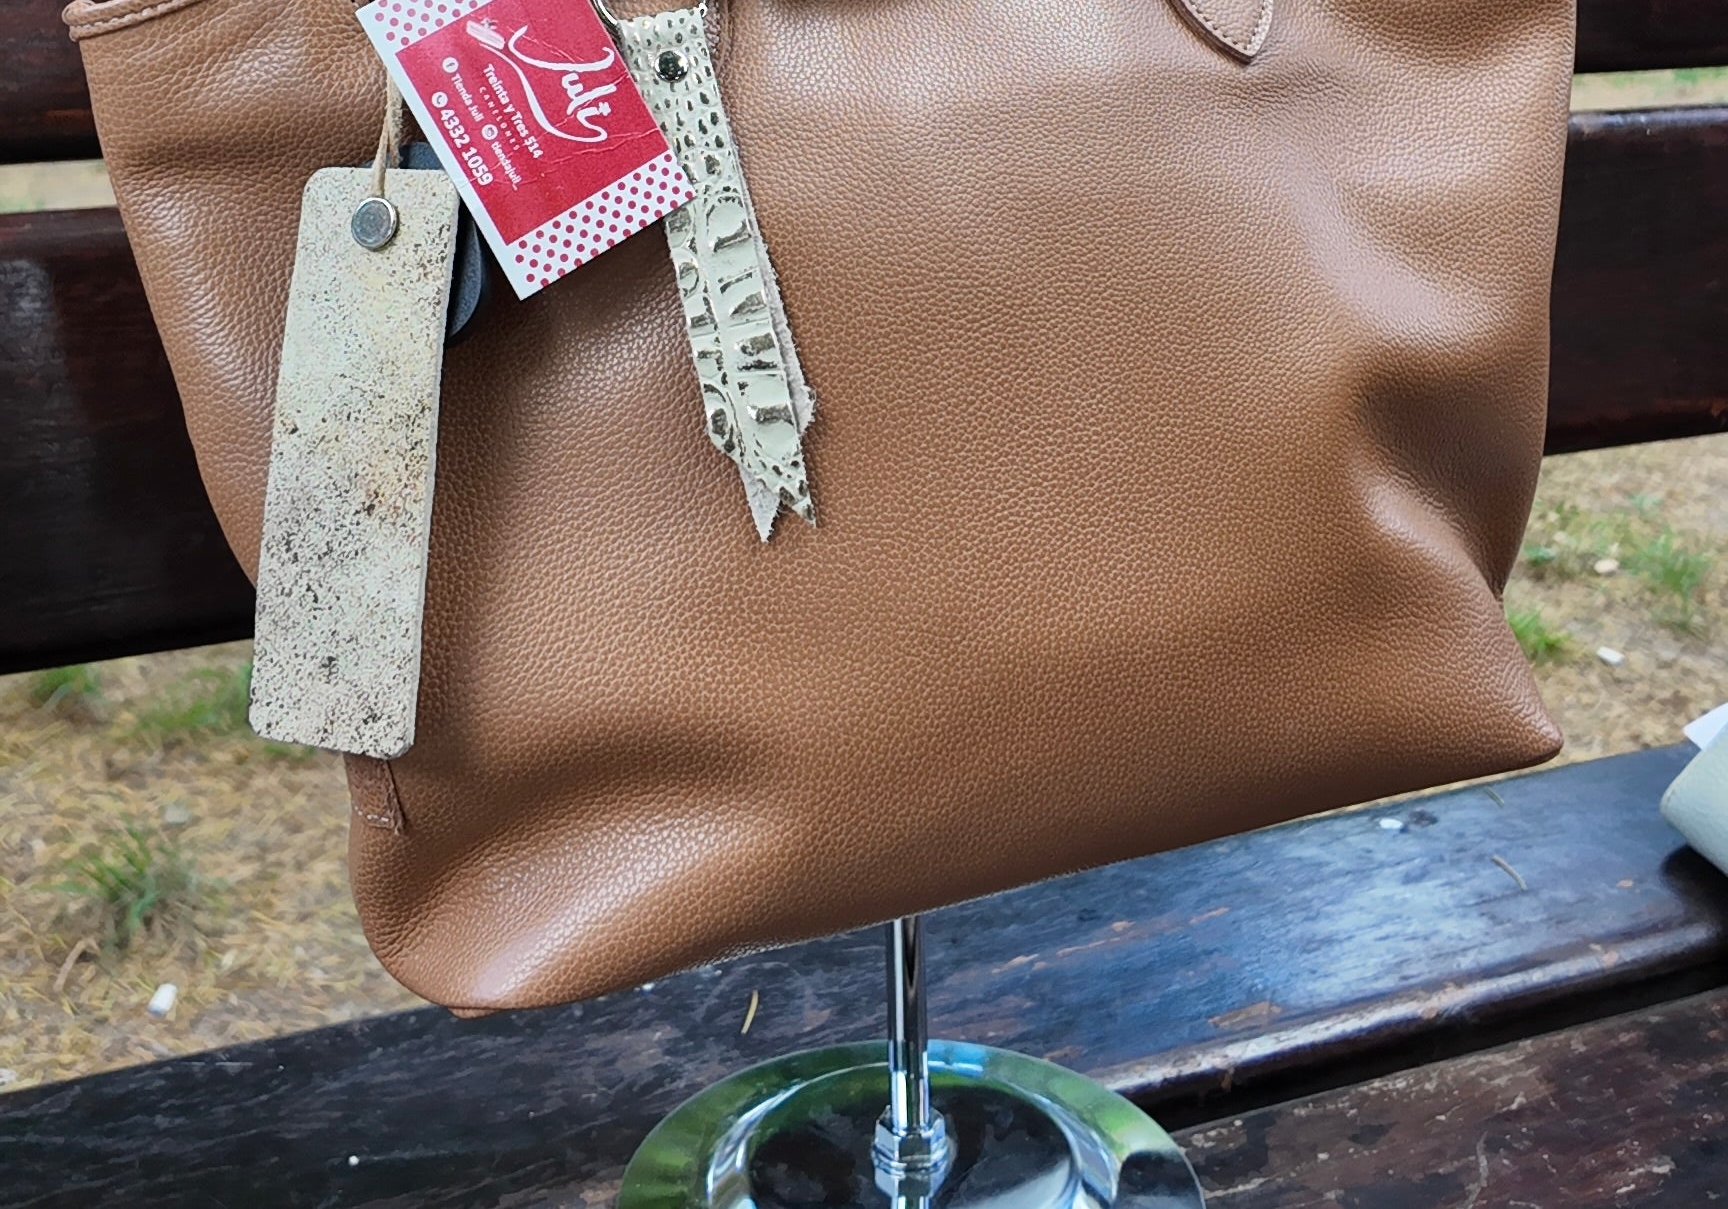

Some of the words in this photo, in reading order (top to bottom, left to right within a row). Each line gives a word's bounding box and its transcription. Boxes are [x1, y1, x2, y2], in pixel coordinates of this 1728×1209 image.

[451, 73, 473, 106] Tienda
[468, 105, 484, 122] Juli
[480, 86, 520, 150] CANELONES
[483, 63, 510, 105] Treinta
[503, 104, 515, 113] y
[511, 111, 529, 138] Tres
[524, 136, 544, 158] 514
[500, 25, 617, 142] Juli
[440, 109, 470, 148] 4332
[461, 146, 494, 186] 1059
